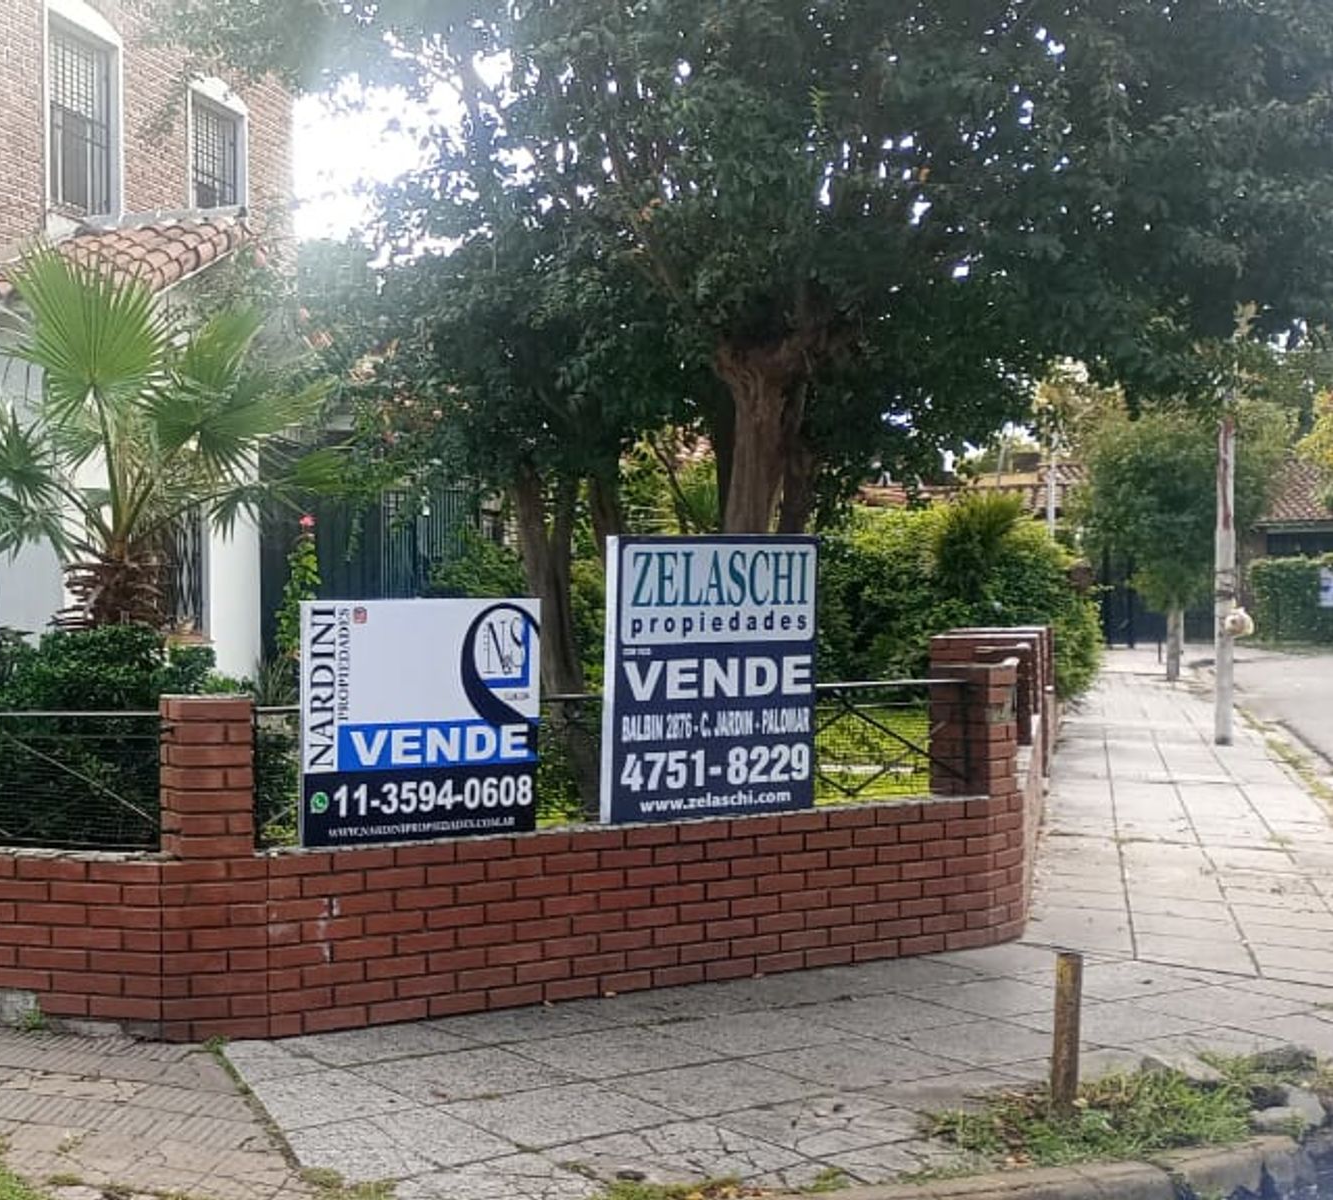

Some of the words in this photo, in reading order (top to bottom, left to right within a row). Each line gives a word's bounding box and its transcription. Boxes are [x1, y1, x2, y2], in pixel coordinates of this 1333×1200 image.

[631, 550, 808, 607] ZELASCHI
[631, 611, 808, 638] propiedades
[337, 608, 350, 721] PROPIEDADES
[623, 655, 812, 700] VENDE
[309, 607, 336, 767] NARDINI
[351, 723, 529, 766] VENDE
[622, 715, 663, 742] BALBIN
[714, 710, 754, 736] JARDIN
[762, 707, 810, 734] PALOMAR
[333, 775, 532, 817] 11-3594-0608
[640, 790, 791, 812] www.zelaschi.com
